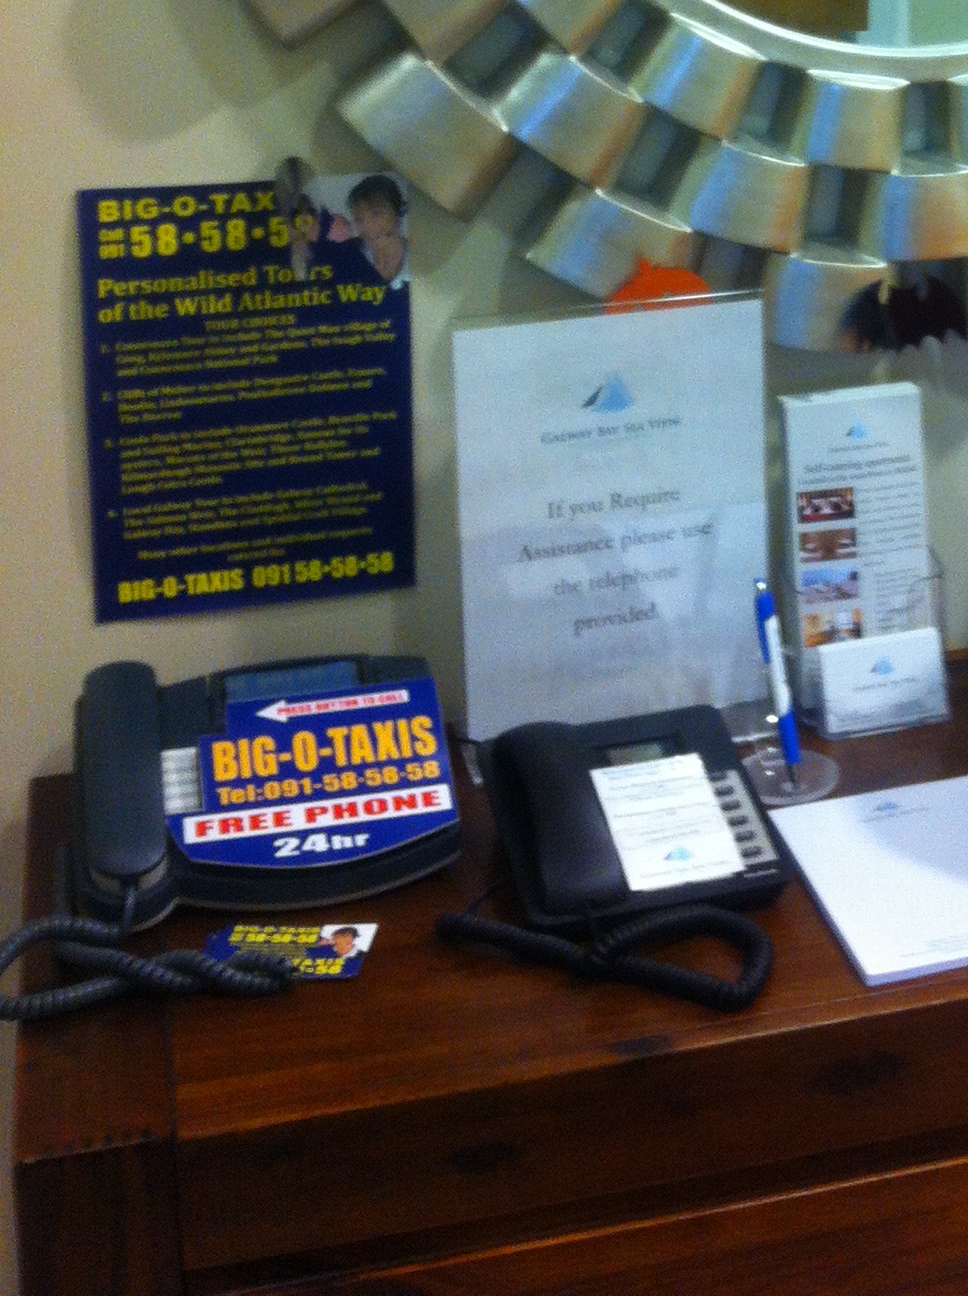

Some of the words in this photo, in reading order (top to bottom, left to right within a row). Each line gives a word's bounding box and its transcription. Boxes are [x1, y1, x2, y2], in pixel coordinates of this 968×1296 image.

[98, 191, 276, 223] BIG-O-TAX
[97, 267, 258, 299] Personalised
[264, 264, 333, 285] Tors
[98, 303, 123, 324] of
[129, 301, 169, 321] the
[175, 293, 233, 317] Wild
[238, 290, 333, 312] Atlantic
[337, 284, 387, 306] Way
[547, 499, 565, 519] If
[569, 501, 604, 520] you
[610, 488, 680, 513] Require
[519, 538, 614, 563] Assistance
[620, 528, 675, 552] please
[681, 522, 714, 538] use
[118, 569, 245, 603] BIG-O-TAXIS
[553, 579, 583, 596] the
[589, 566, 679, 591] telephone
[574, 601, 660, 637] provided
[211, 715, 439, 783] BIG-O-TAXIS
[194, 810, 294, 839] FREE
[304, 790, 442, 824] PHONE
[272, 831, 371, 859] 24hr
